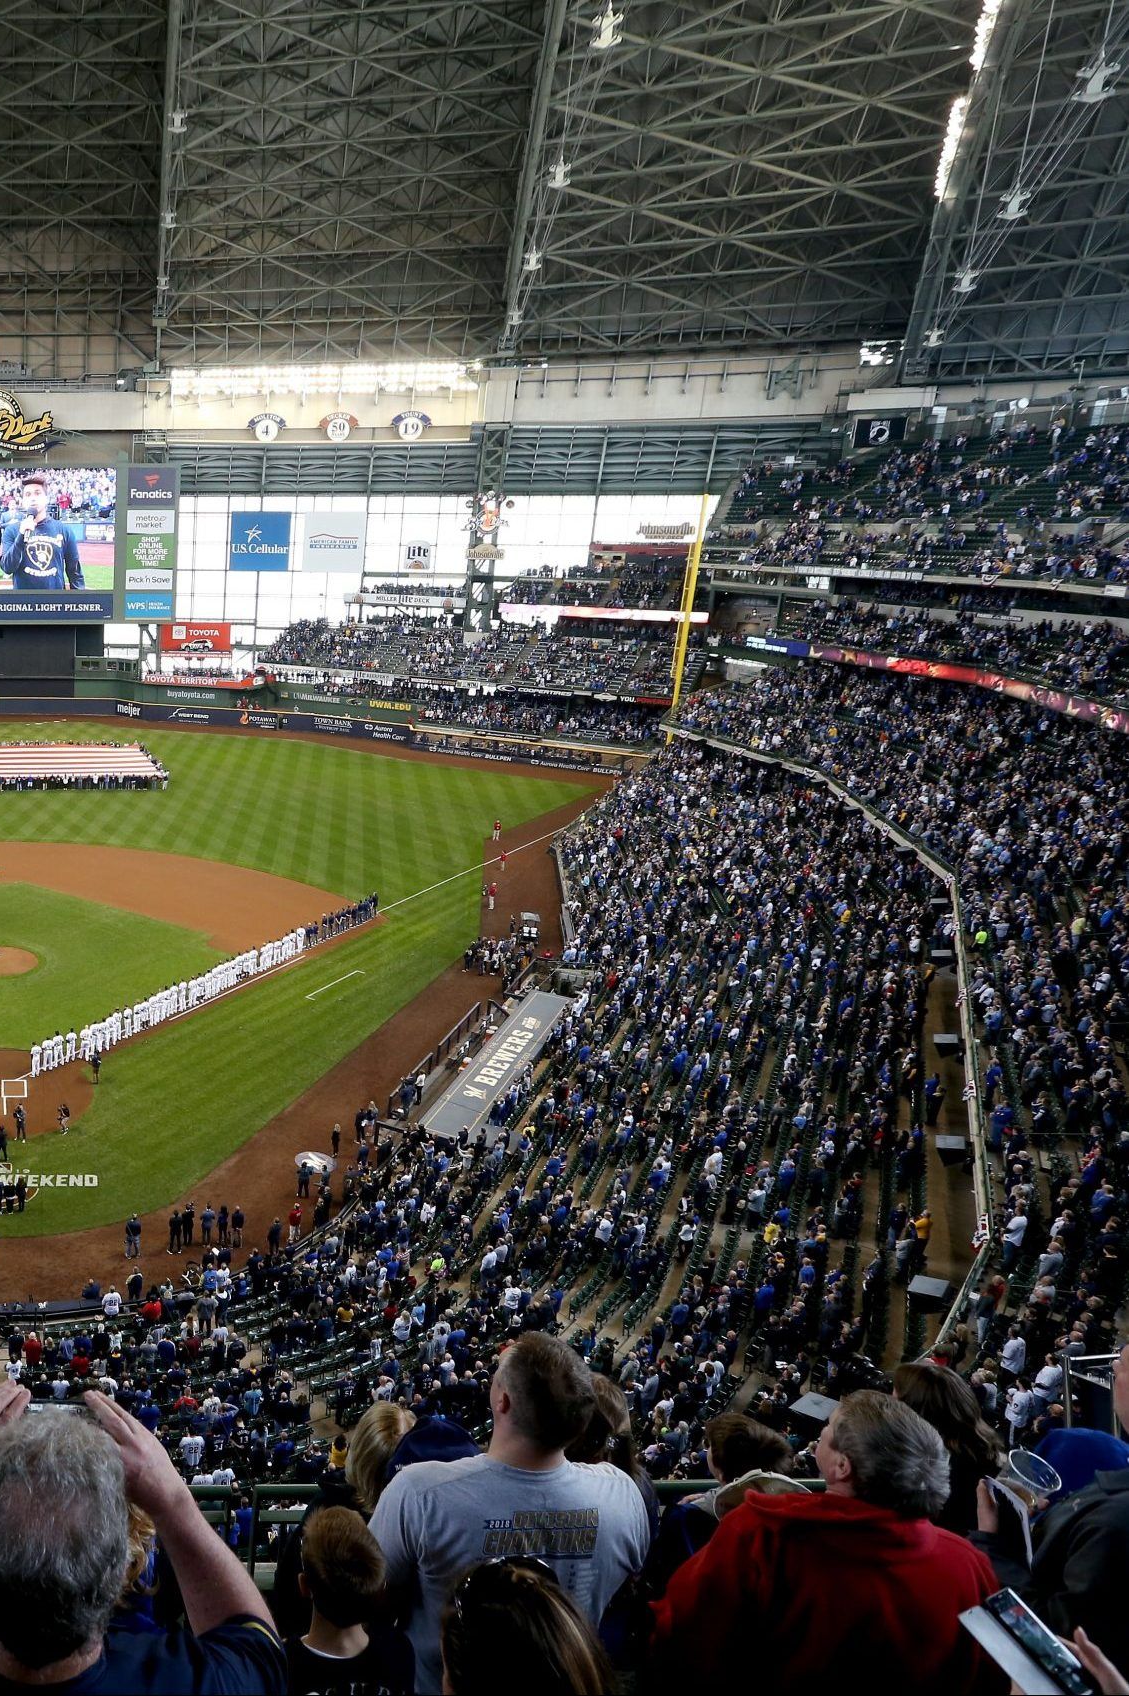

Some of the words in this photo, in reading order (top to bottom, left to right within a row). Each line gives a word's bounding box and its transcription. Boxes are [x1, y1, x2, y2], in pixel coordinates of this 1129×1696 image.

[1, 411, 53, 443] Park
[261, 424, 269, 436] 4
[331, 421, 345, 432] 50
[403, 422, 419, 435] 19
[18, 442, 46, 451] BREWERS
[130, 488, 173, 499] Fanatics
[249, 543, 289, 554] Cellular
[406, 545, 429, 560] Lite
[128, 576, 144, 584] Pick
[152, 576, 171, 584] Save
[35, 604, 62, 612] LIGHT
[64, 604, 104, 612] PILSNER.
[127, 602, 145, 610] WPS
[189, 629, 220, 637] TOYOTA
[145, 675, 175, 683] TOYOTA
[176, 677, 218, 686] TERRITORY
[167, 689, 215, 699] buyatoyota.com
[117, 702, 141, 717] meijer
[370, 700, 412, 711] UWM.EDU
[314, 717, 333, 726] TOWN
[333, 718, 353, 728] BANK
[373, 725, 393, 733] Aurora
[373, 732, 392, 740] Health
[392, 733, 407, 741] Care
[437, 747, 454, 756] Aurora
[455, 749, 470, 757] Health
[485, 754, 512, 762] BULLPEN
[540, 760, 558, 768] Aurora
[558, 762, 576, 770] Health
[577, 764, 591, 772] Care
[474, 1029, 534, 1087] BREWERS
[513, 1507, 600, 1529] DIVISION
[483, 1528, 599, 1556] CHAMPIONS
